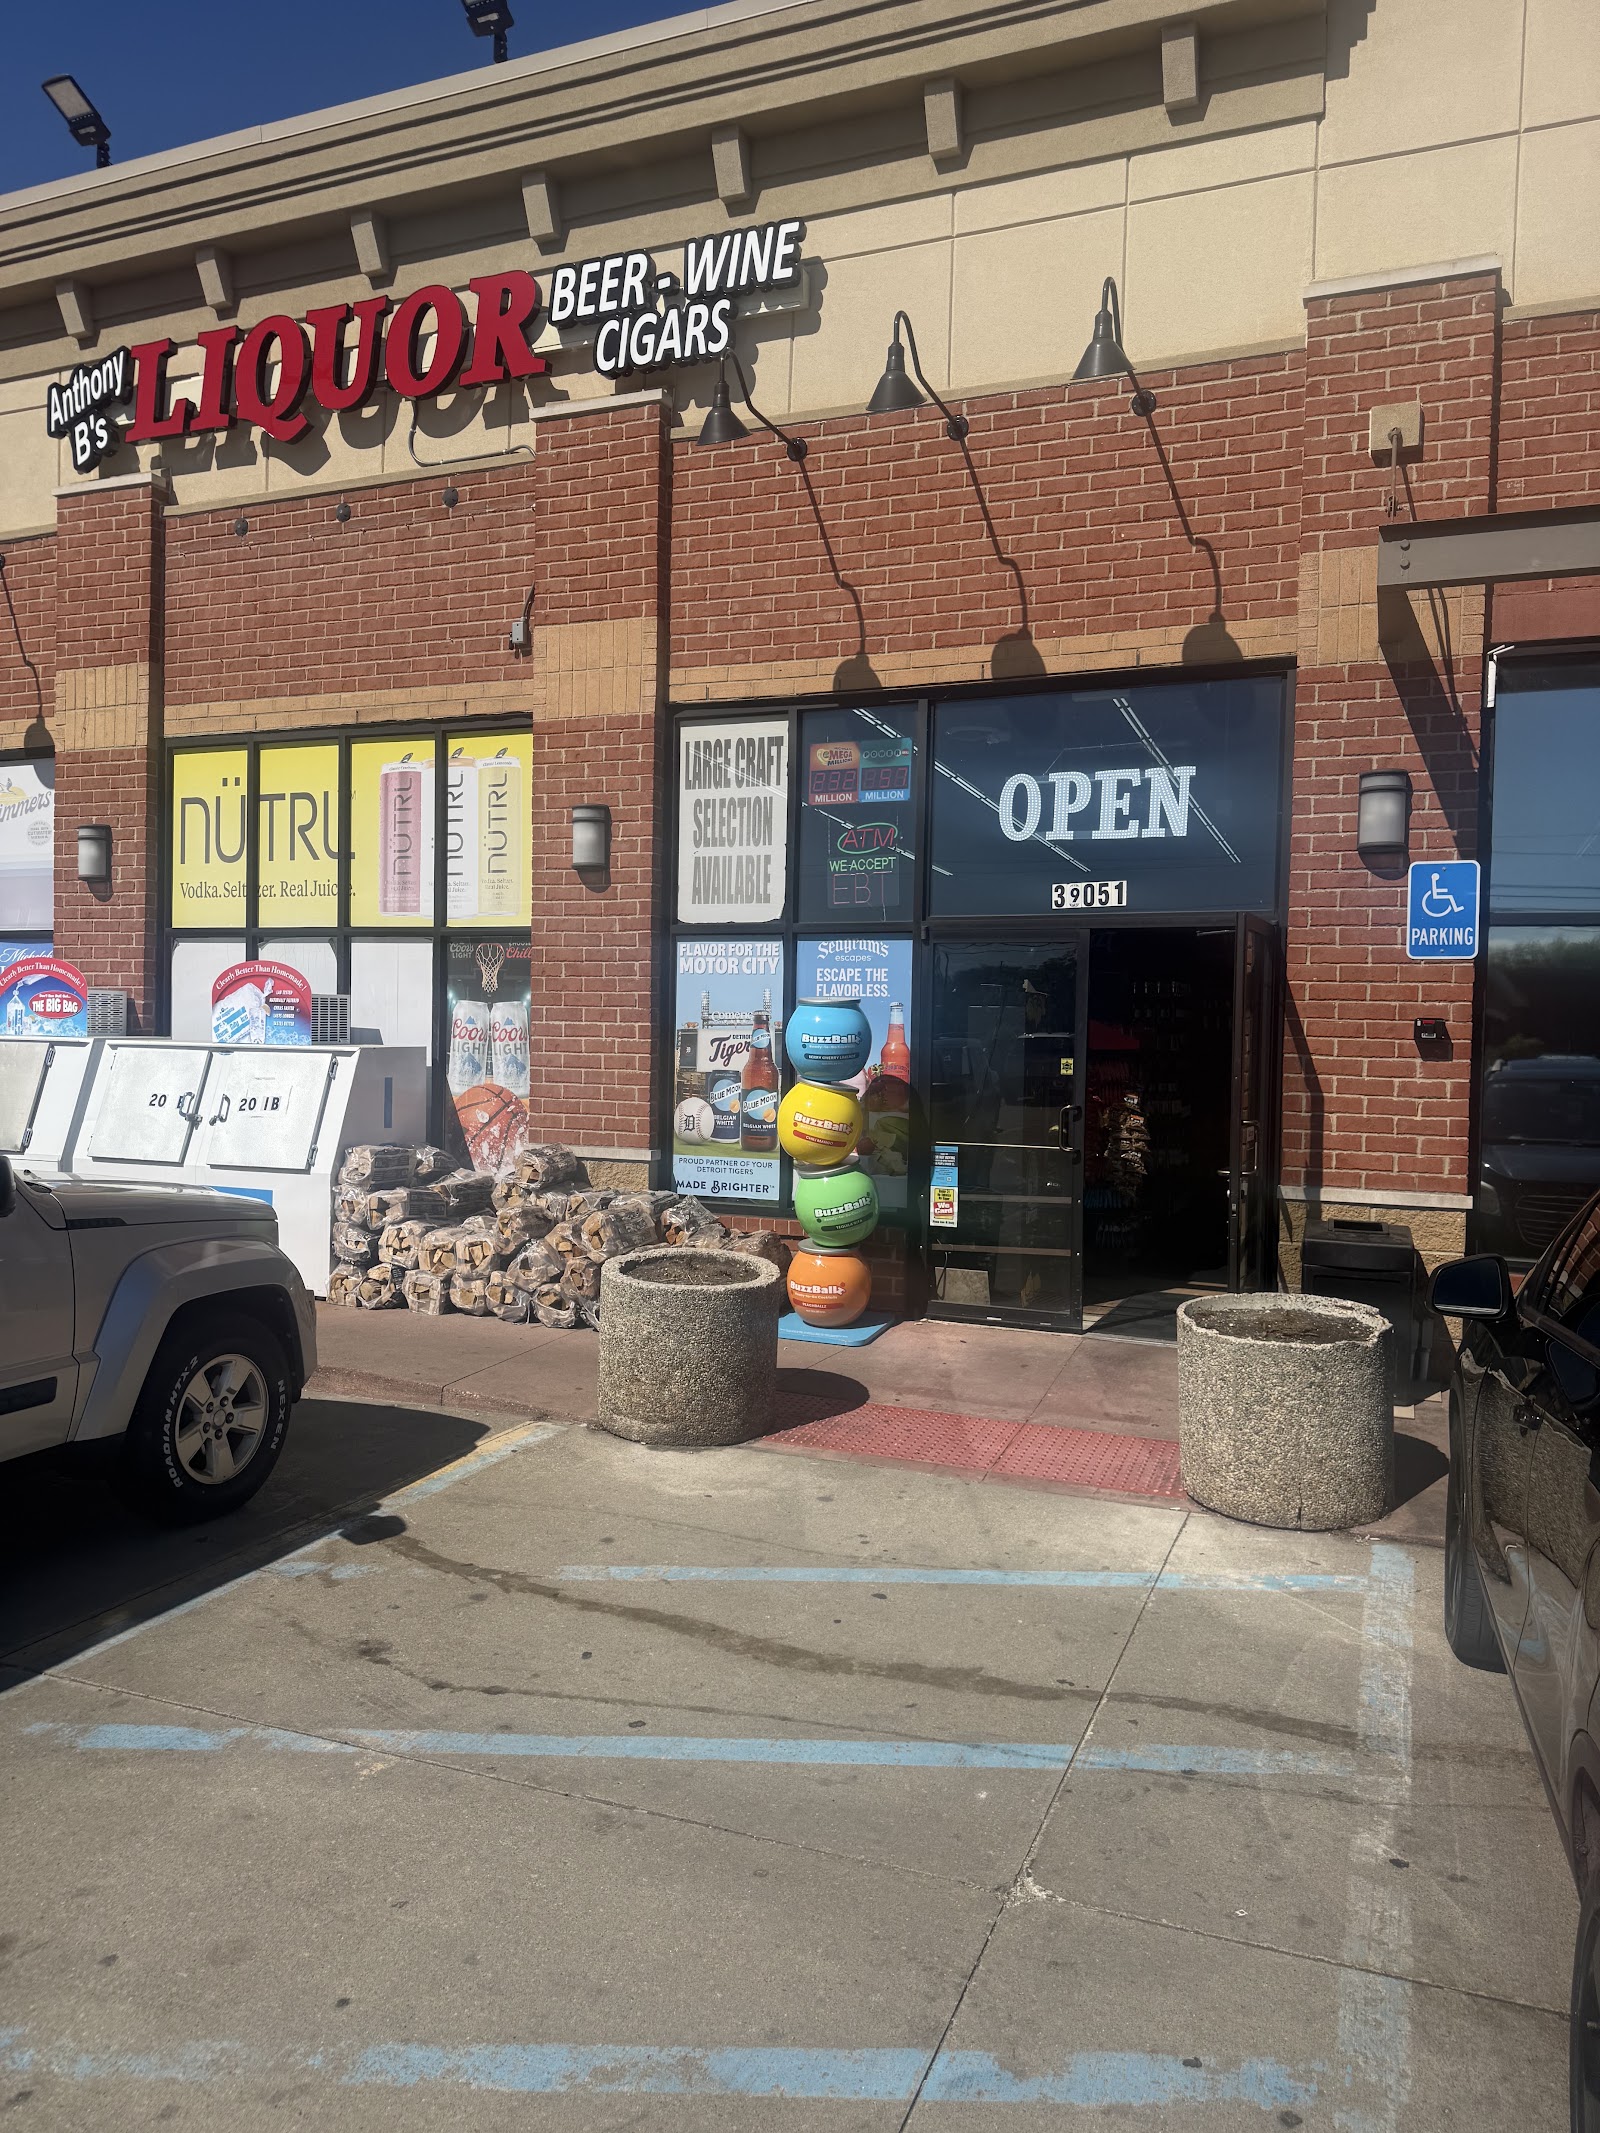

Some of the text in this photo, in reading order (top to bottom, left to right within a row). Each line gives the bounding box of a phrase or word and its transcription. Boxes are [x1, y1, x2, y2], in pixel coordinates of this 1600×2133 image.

[551, 253, 648, 321] BEER
[687, 221, 800, 296] WINE
[597, 299, 731, 372] CIGARS
[125, 270, 552, 443] LIQUOR
[50, 350, 124, 433] Anthony
[74, 415, 109, 466] B's
[684, 736, 784, 791] LARGE CRAFT
[829, 749, 853, 760] MEGA
[814, 793, 853, 803] MILLION
[865, 790, 905, 800] MILLION
[998, 765, 1197, 843] OPEN
[693, 796, 773, 849] SELECTION
[842, 828, 895, 849] ATM
[829, 857, 897, 872] WE ACCEPT
[692, 854, 771, 905] AVAILABLE
[833, 871, 893, 904] EBT
[180, 881, 222, 899] Vodka.
[280, 880, 308, 897] Real
[1053, 882, 1126, 908] 39051
[1411, 927, 1474, 946] PARKING
[449, 943, 474, 952] Coors
[680, 943, 780, 957] FLAVOR FOR THE
[17, 964, 35, 974] Better
[35, 962, 50, 970] Than
[680, 957, 780, 975] MOTOR CITY
[835, 955, 872, 963] escapes
[216, 972, 234, 990] Clearly
[235, 967, 254, 977] Better
[254, 964, 271, 973] Than
[271, 966, 305, 989] Homemade
[816, 967, 889, 982] ESCAPE THE
[816, 983, 891, 998] FLAVORLESS.
[32, 998, 79, 1013] THE BIG BAG
[149, 1093, 168, 1107] 20
[238, 1097, 257, 1112] 20
[710, 1091, 726, 1103] BLUE
[743, 1093, 777, 1112] BLUE MOON
[679, 1157, 704, 1165] PROUD
[706, 1158, 738, 1167] PARTNER
[752, 1161, 773, 1169] YOUR
[697, 1166, 754, 1175] DETROIT TIGERS
[676, 1179, 707, 1190] MADE
[790, 1281, 846, 1295] BuzzBallz
[270, 1379, 287, 1450] NEXEN
[163, 1408, 184, 1488] ROADIAN
